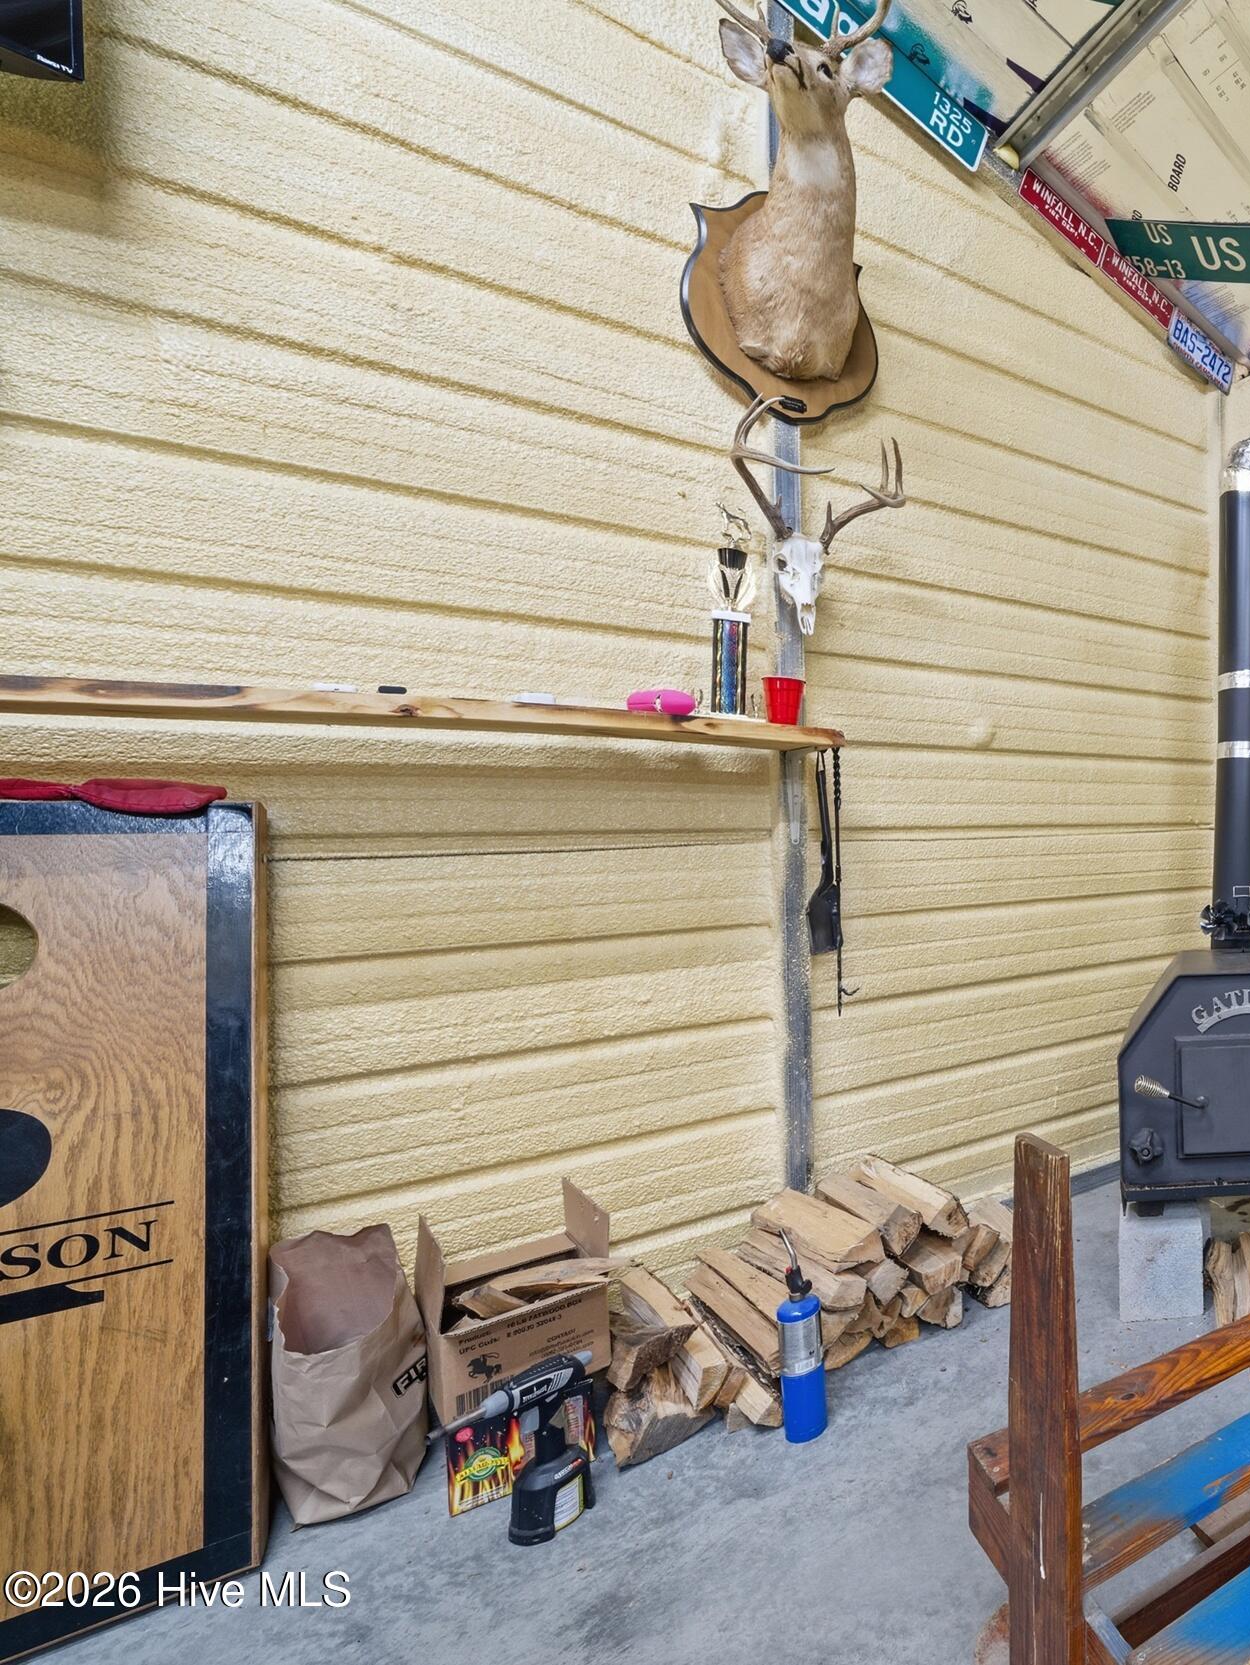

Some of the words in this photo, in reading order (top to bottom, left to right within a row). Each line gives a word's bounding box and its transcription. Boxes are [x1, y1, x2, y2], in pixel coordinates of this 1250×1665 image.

[929, 110, 963, 147] RD
[932, 92, 972, 134] 1325
[1168, 153, 1187, 193] BOARD
[1033, 179, 1074, 225] WINFALL
[1143, 222, 1173, 246] US
[1190, 235, 1247, 272] US
[1112, 254, 1150, 293] WINFALL
[1127, 254, 1186, 279] 58-13
[1173, 319, 1232, 384] BAS-2472
